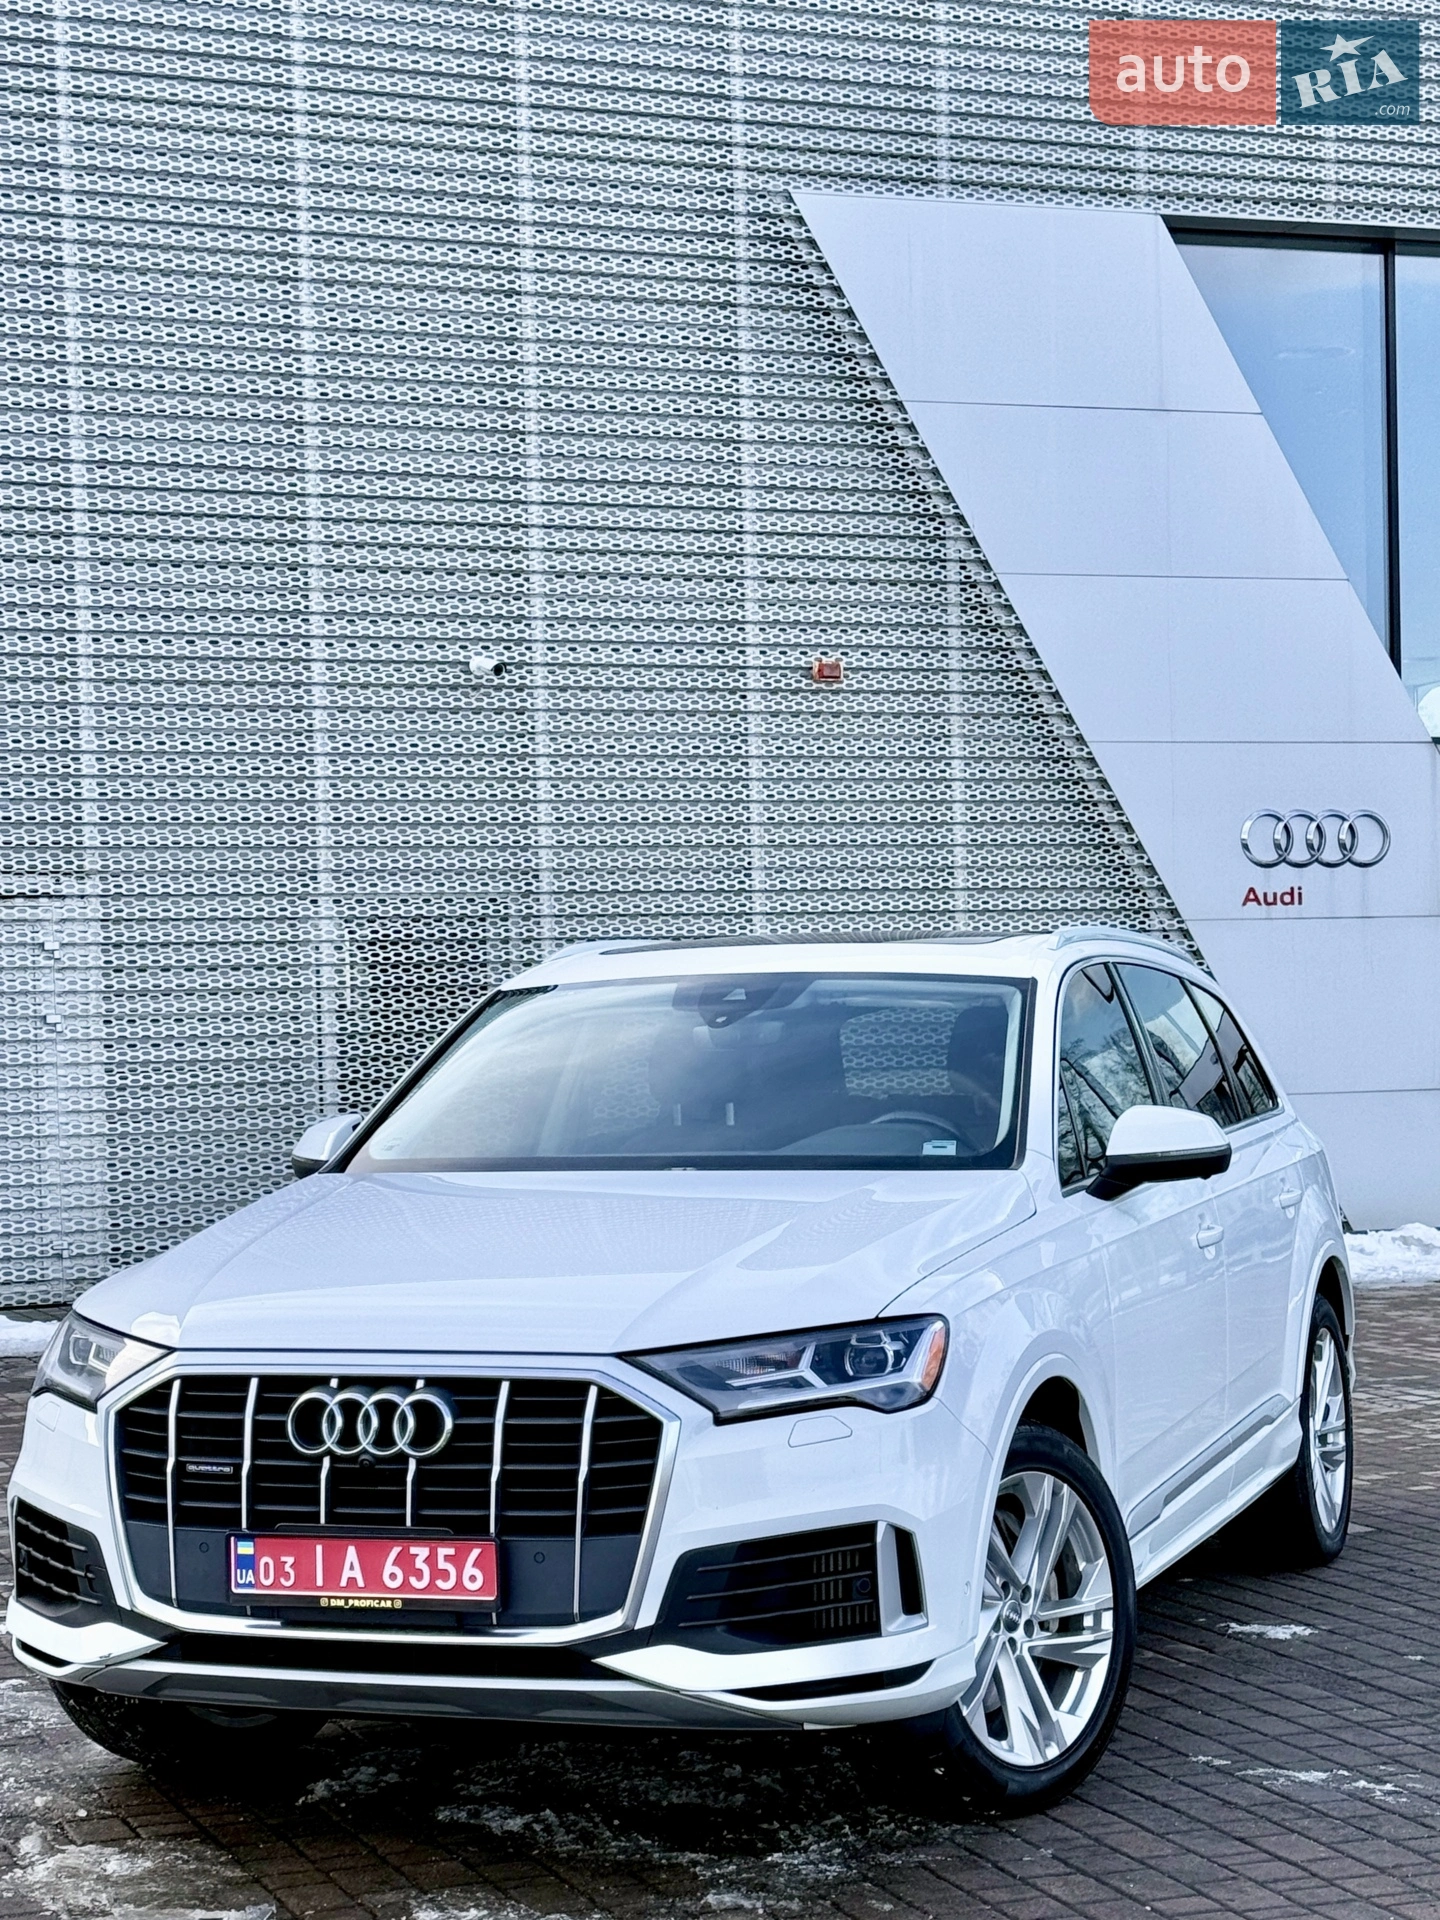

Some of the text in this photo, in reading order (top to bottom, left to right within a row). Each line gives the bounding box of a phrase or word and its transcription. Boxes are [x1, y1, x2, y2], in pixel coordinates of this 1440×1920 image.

[1242, 886, 1303, 907] Audi
[237, 1569, 255, 1584] UA
[259, 1545, 484, 1591] 03 IA 6356
